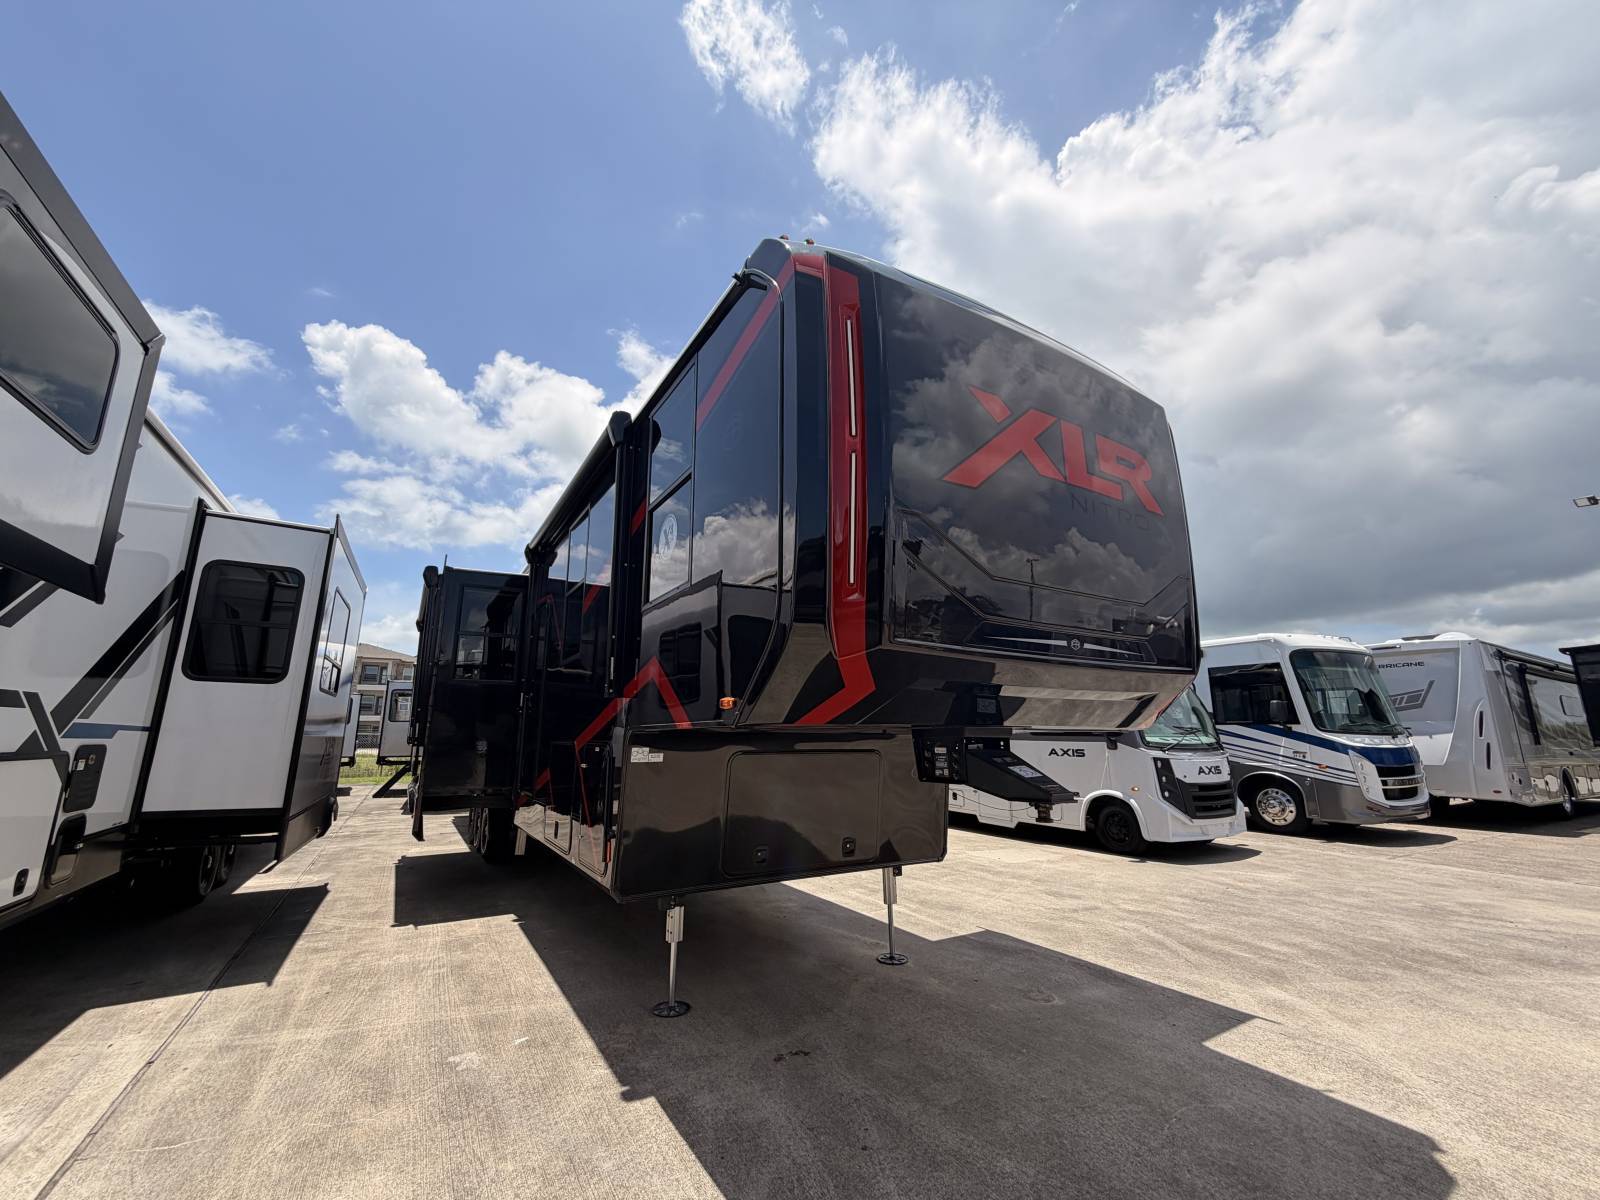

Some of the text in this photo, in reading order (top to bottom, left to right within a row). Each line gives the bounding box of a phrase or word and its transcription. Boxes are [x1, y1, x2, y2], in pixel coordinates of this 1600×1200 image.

[942, 386, 1164, 516] XLR
[1048, 748, 1086, 758] AXIS
[1198, 765, 1222, 776] AXIS
